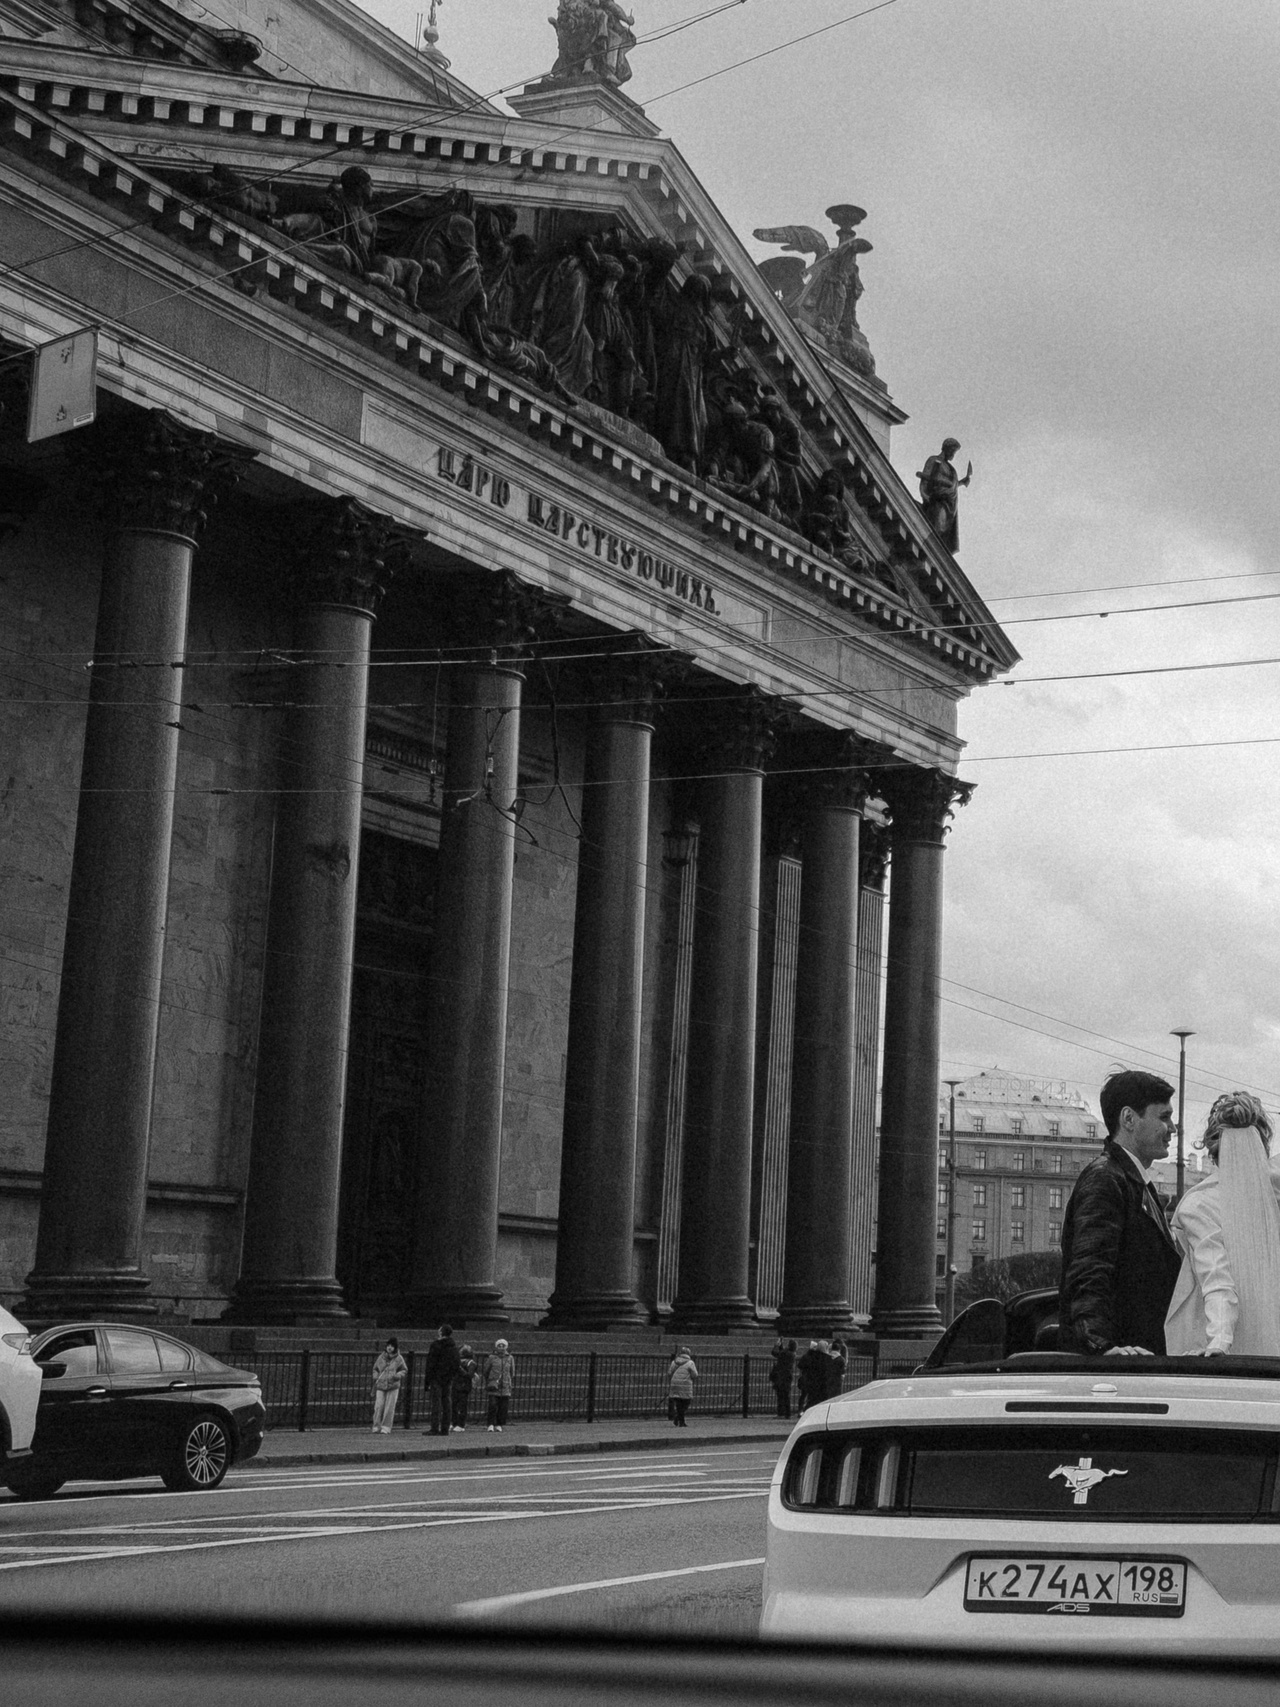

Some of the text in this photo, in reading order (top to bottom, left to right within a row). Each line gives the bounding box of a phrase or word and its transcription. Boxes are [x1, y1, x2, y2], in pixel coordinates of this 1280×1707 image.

[437, 447, 511, 508] ЦАРЮ
[1123, 1565, 1174, 1592] 198
[1133, 1592, 1159, 1603] RUS
